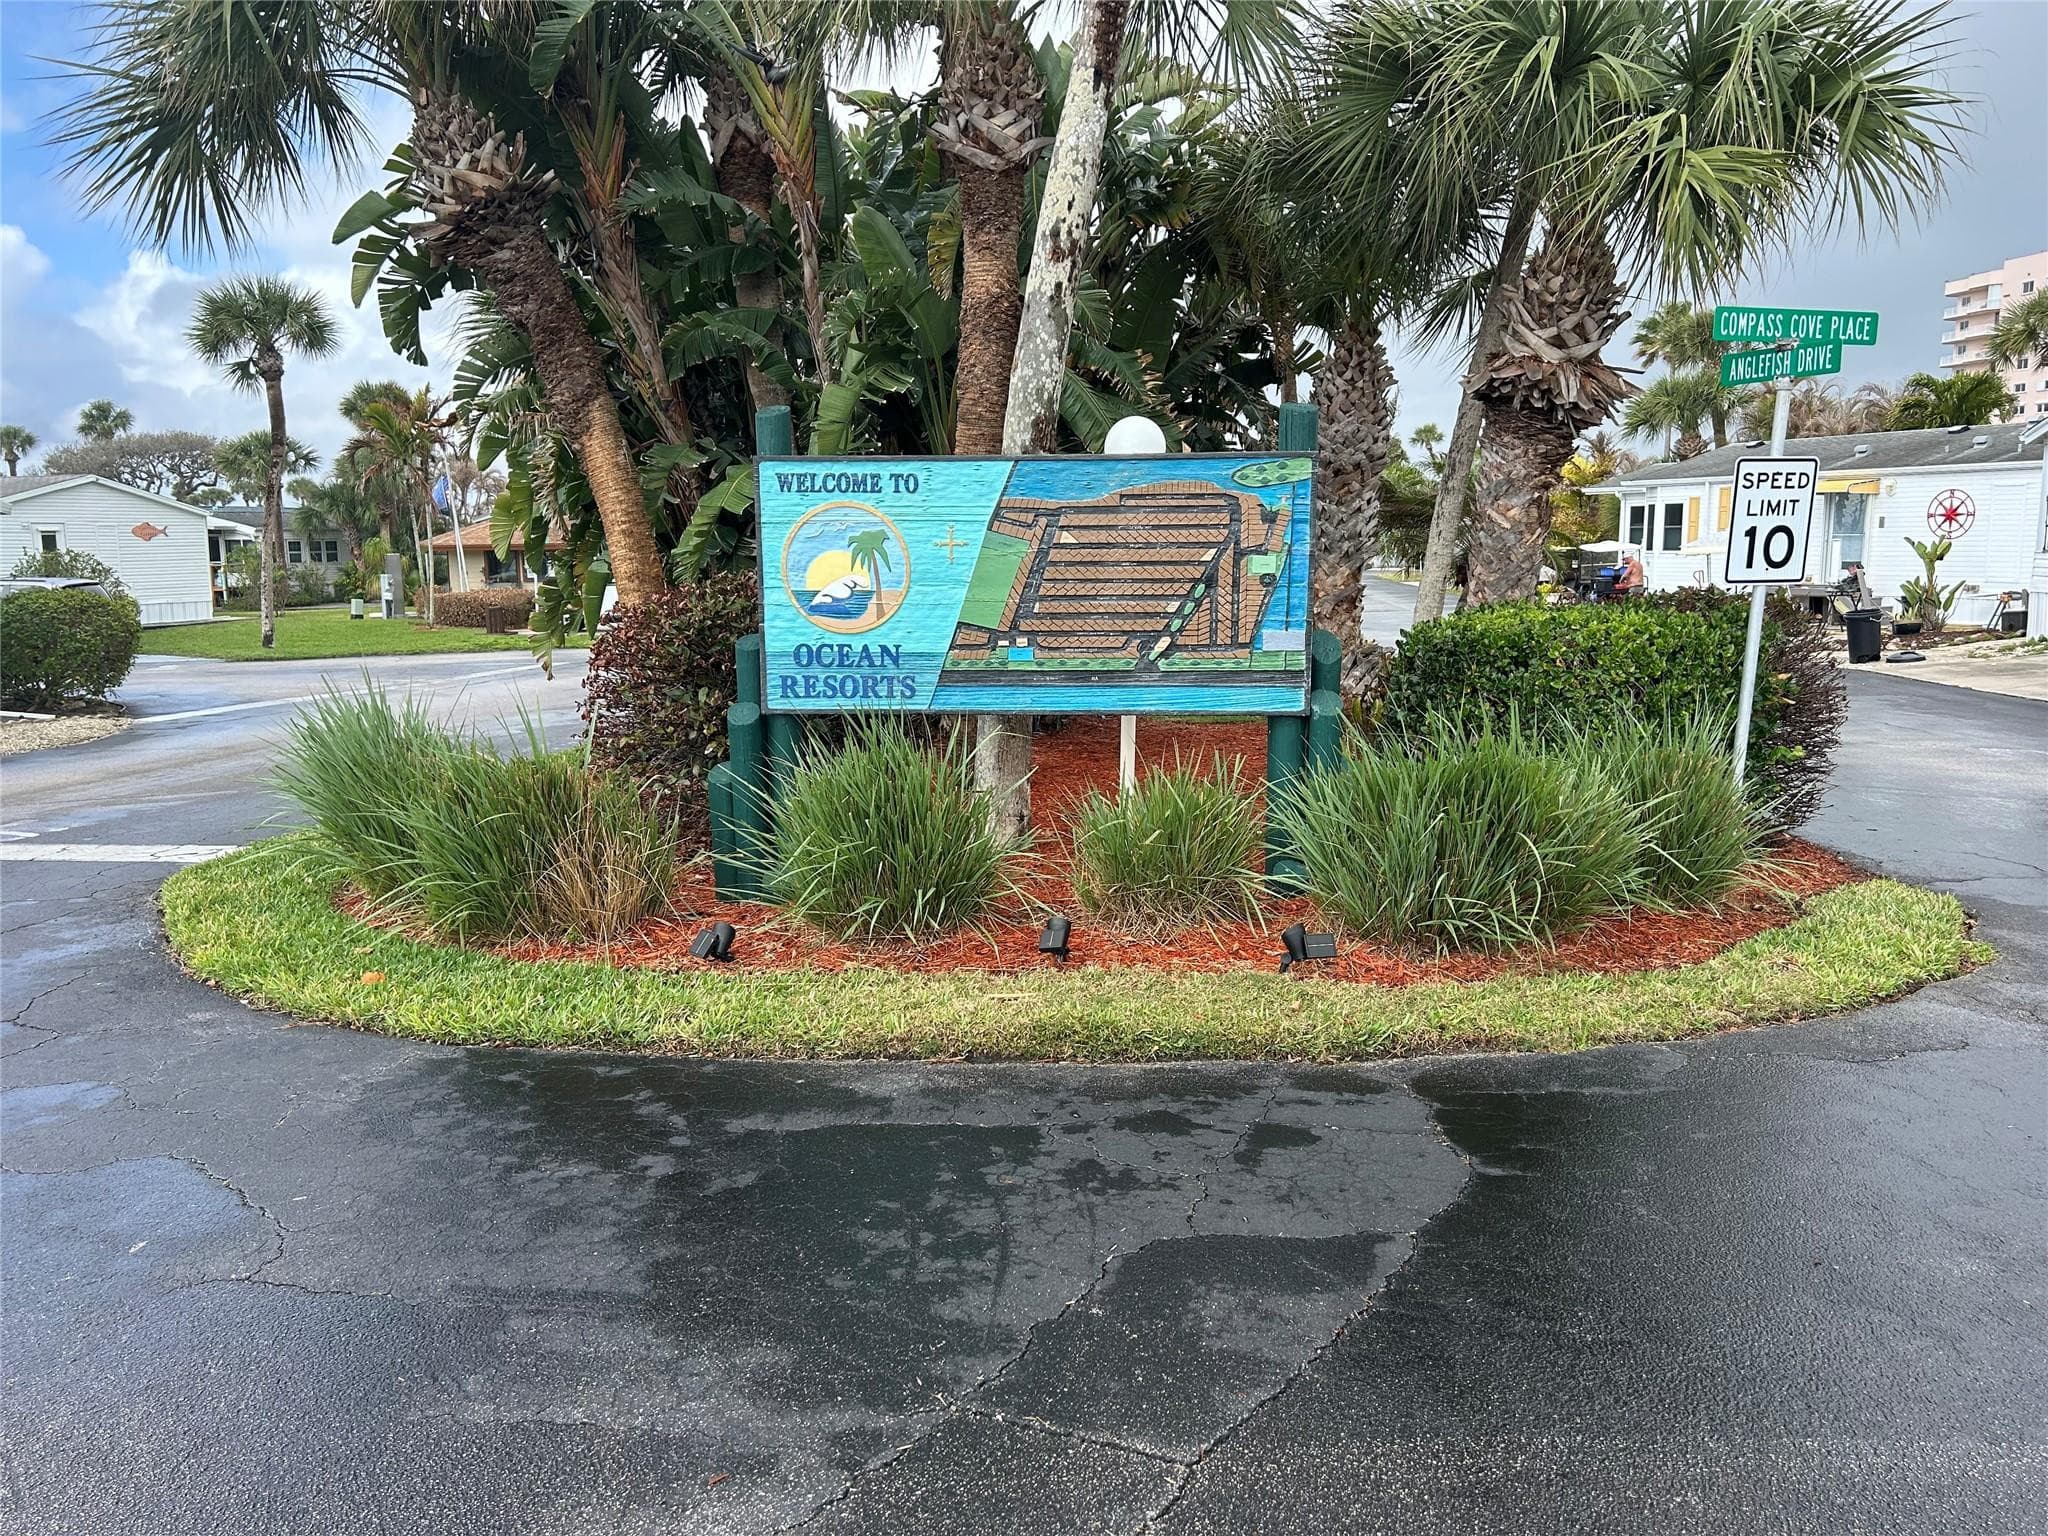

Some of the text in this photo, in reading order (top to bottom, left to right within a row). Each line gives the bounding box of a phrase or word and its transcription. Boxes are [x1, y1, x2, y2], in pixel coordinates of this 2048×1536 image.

[1720, 312, 1871, 341] COMPASS COVE PLACE
[1729, 345, 1833, 381] ANGLEFISH DRIVE
[775, 472, 919, 494] WELCOME TO
[1742, 472, 1810, 489] SPEED
[1747, 499, 1800, 516] LIMIT
[1744, 525, 1795, 569] 10
[793, 643, 902, 668] OCEAN
[779, 674, 917, 699] RESORTS
